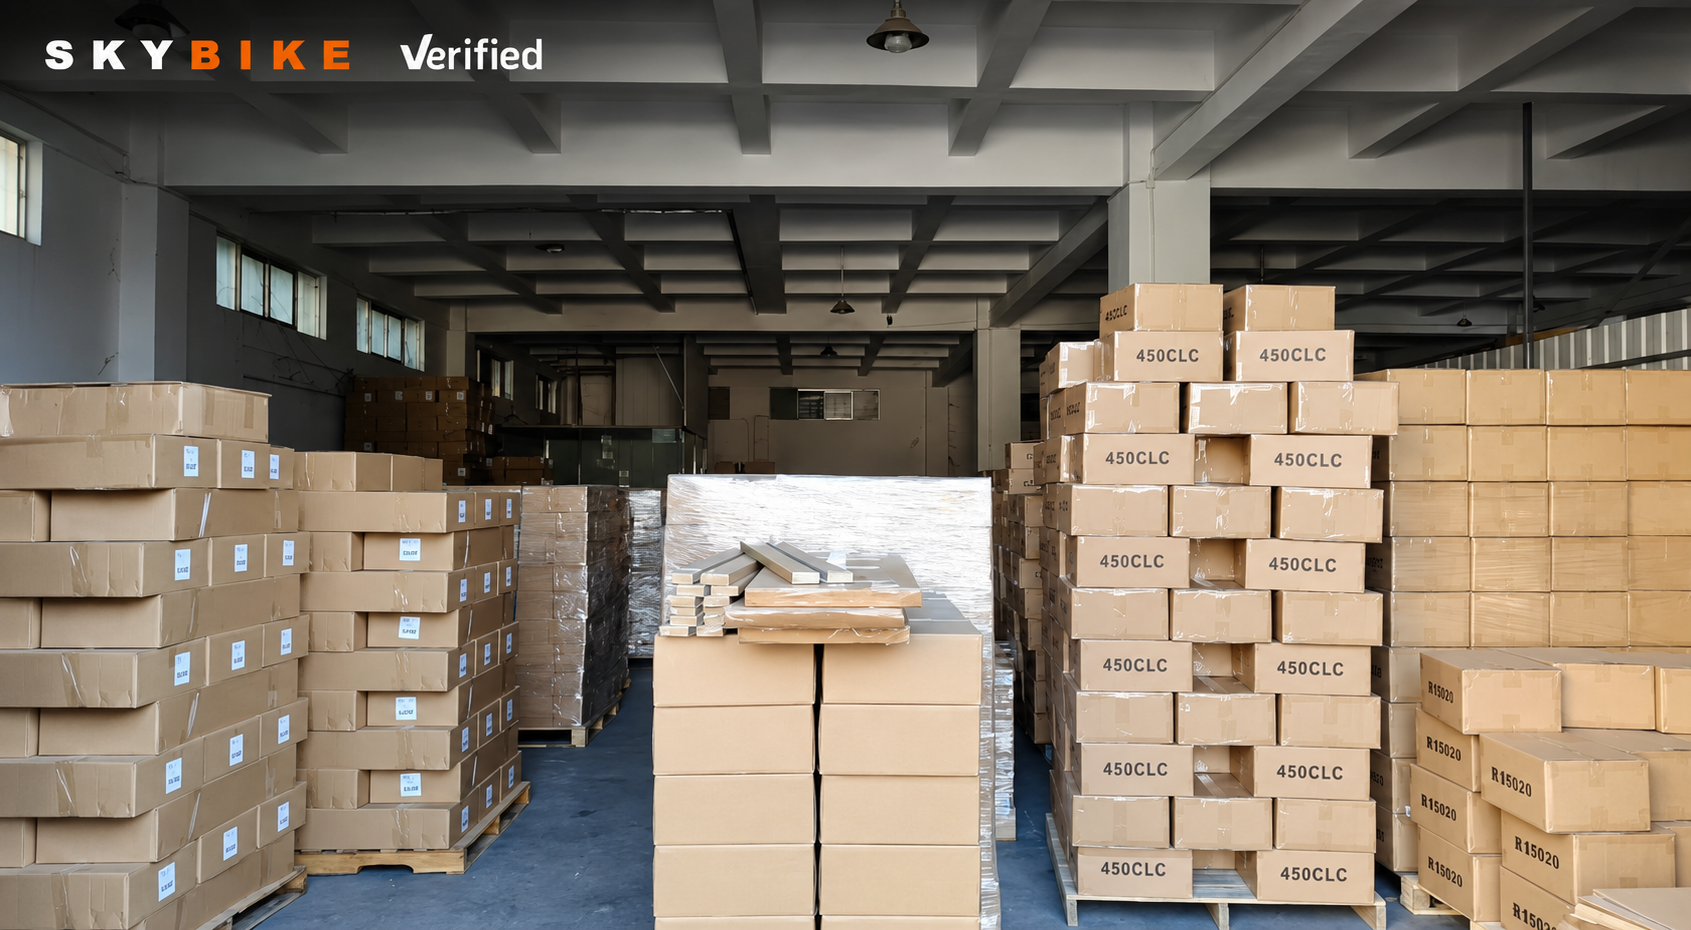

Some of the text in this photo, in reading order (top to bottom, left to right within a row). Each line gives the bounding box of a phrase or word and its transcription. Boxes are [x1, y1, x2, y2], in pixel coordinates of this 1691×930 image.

[1136, 348, 1199, 363] 450CLC
[1259, 347, 1327, 363] 450CLC
[1105, 450, 1170, 466] 450CLC
[1274, 452, 1343, 468] 450CLC
[1100, 554, 1165, 569] 450CLC
[1268, 556, 1337, 573] 450CLC
[1102, 657, 1168, 673] 450CLC
[1277, 660, 1344, 677] 450CLC
[1428, 680, 1454, 704] R15020
[1426, 735, 1462, 762] R15020
[1102, 761, 1168, 777] 450CLC
[1276, 764, 1344, 781] 450CLC
[1491, 766, 1532, 798] R15020
[1421, 793, 1457, 822] R15020
[1514, 835, 1560, 870] R15020
[1100, 861, 1166, 877] 450CLC
[1280, 867, 1348, 883] 450CLC
[1427, 856, 1463, 888] R15020
